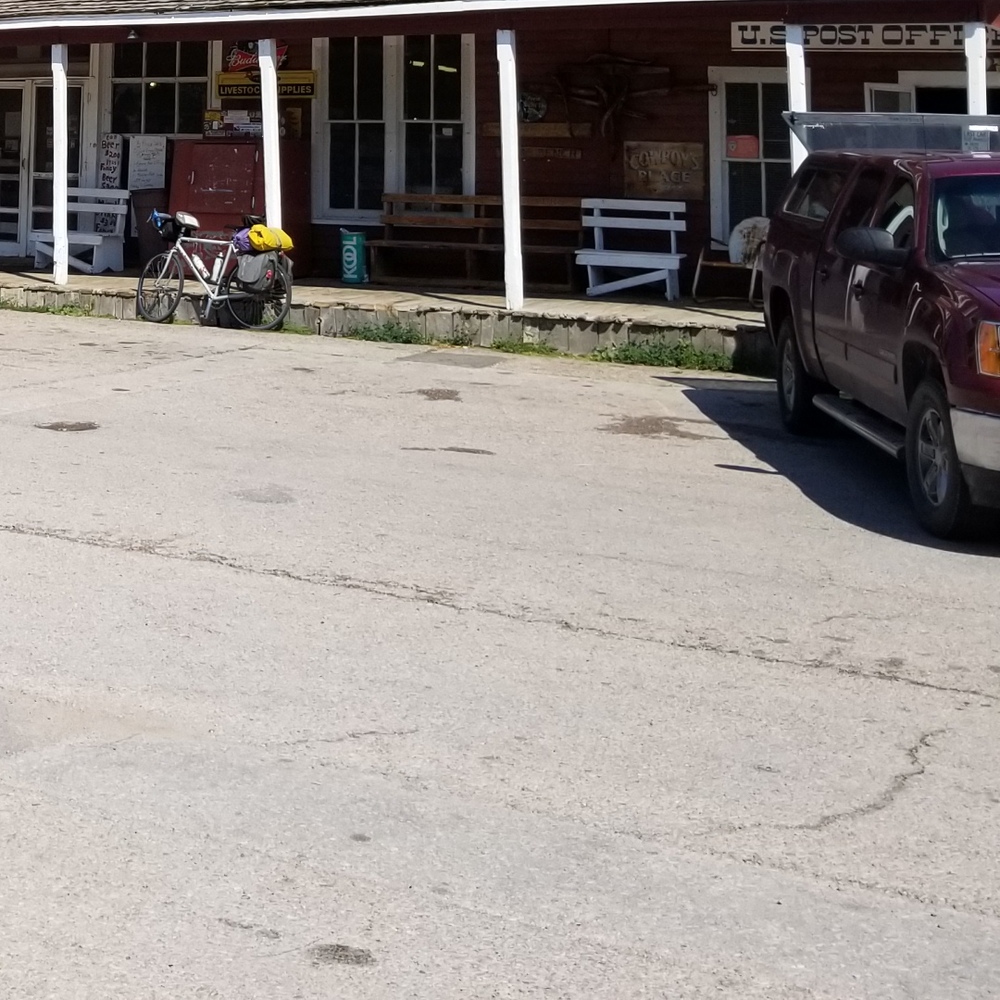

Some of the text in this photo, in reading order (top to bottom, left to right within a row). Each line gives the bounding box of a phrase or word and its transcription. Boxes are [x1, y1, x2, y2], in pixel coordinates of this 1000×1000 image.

[804, 24, 874, 46] POST
[882, 24, 999, 46] OFFI
[220, 86, 312, 94] LIVESTOC PPLIES
[101, 141, 120, 149] Beer
[629, 150, 699, 170] COWBOY'S
[637, 170, 691, 184] PLACE
[343, 236, 358, 278] KOOL
